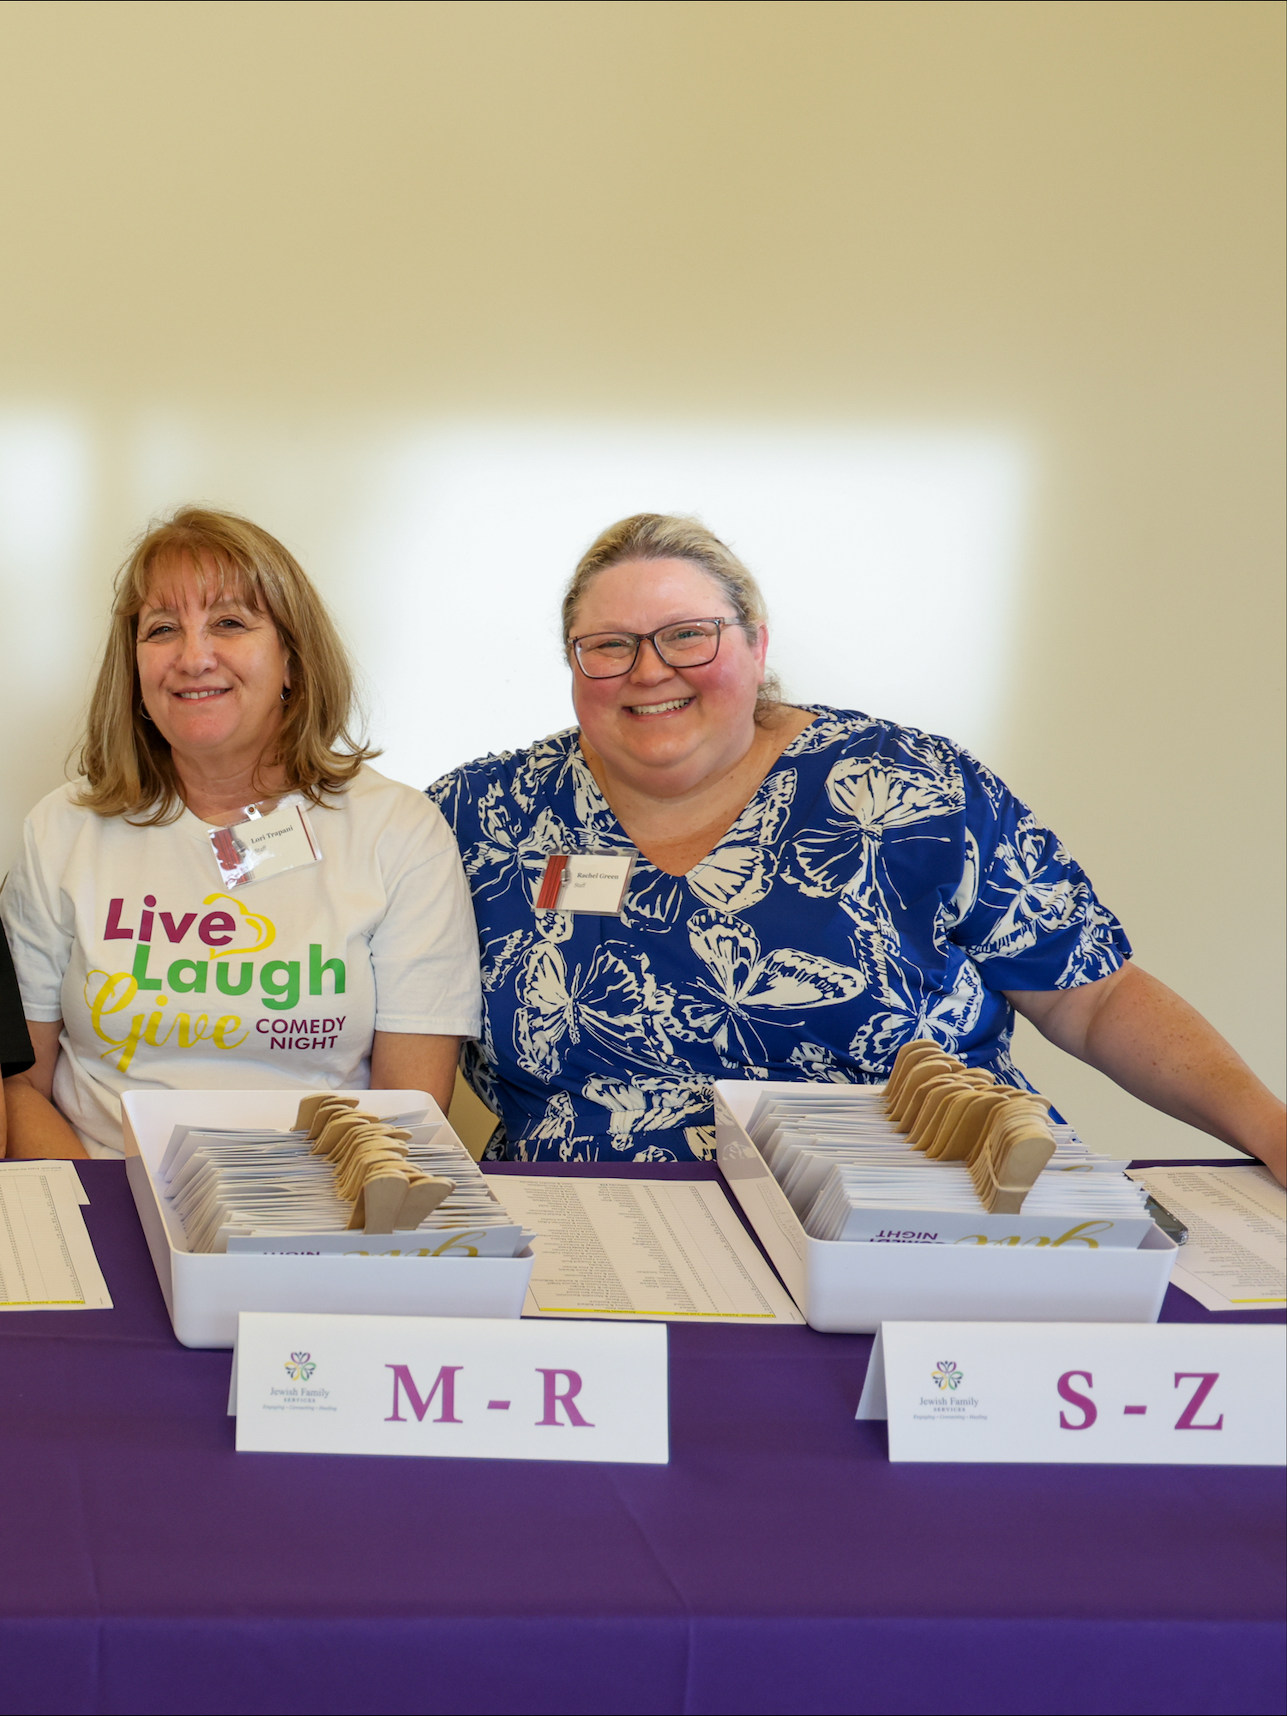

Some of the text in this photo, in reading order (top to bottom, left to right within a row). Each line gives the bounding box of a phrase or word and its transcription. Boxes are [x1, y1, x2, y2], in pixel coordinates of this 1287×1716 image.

[250, 824, 294, 844] Lori Trapani
[599, 872, 620, 880] Green
[103, 894, 236, 946] Live
[131, 943, 346, 1011] Laugh
[83, 969, 250, 1074] Give
[255, 1015, 347, 1035] COMEDY
[270, 1035, 339, 1050] NIGHT
[876, 1230, 938, 1240] NIGHT
[270, 1387, 330, 1399] Jewish Family
[385, 1364, 595, 1427] M - R
[919, 1397, 979, 1408] Jewish Family
[1057, 1370, 1224, 1431] S - Z
